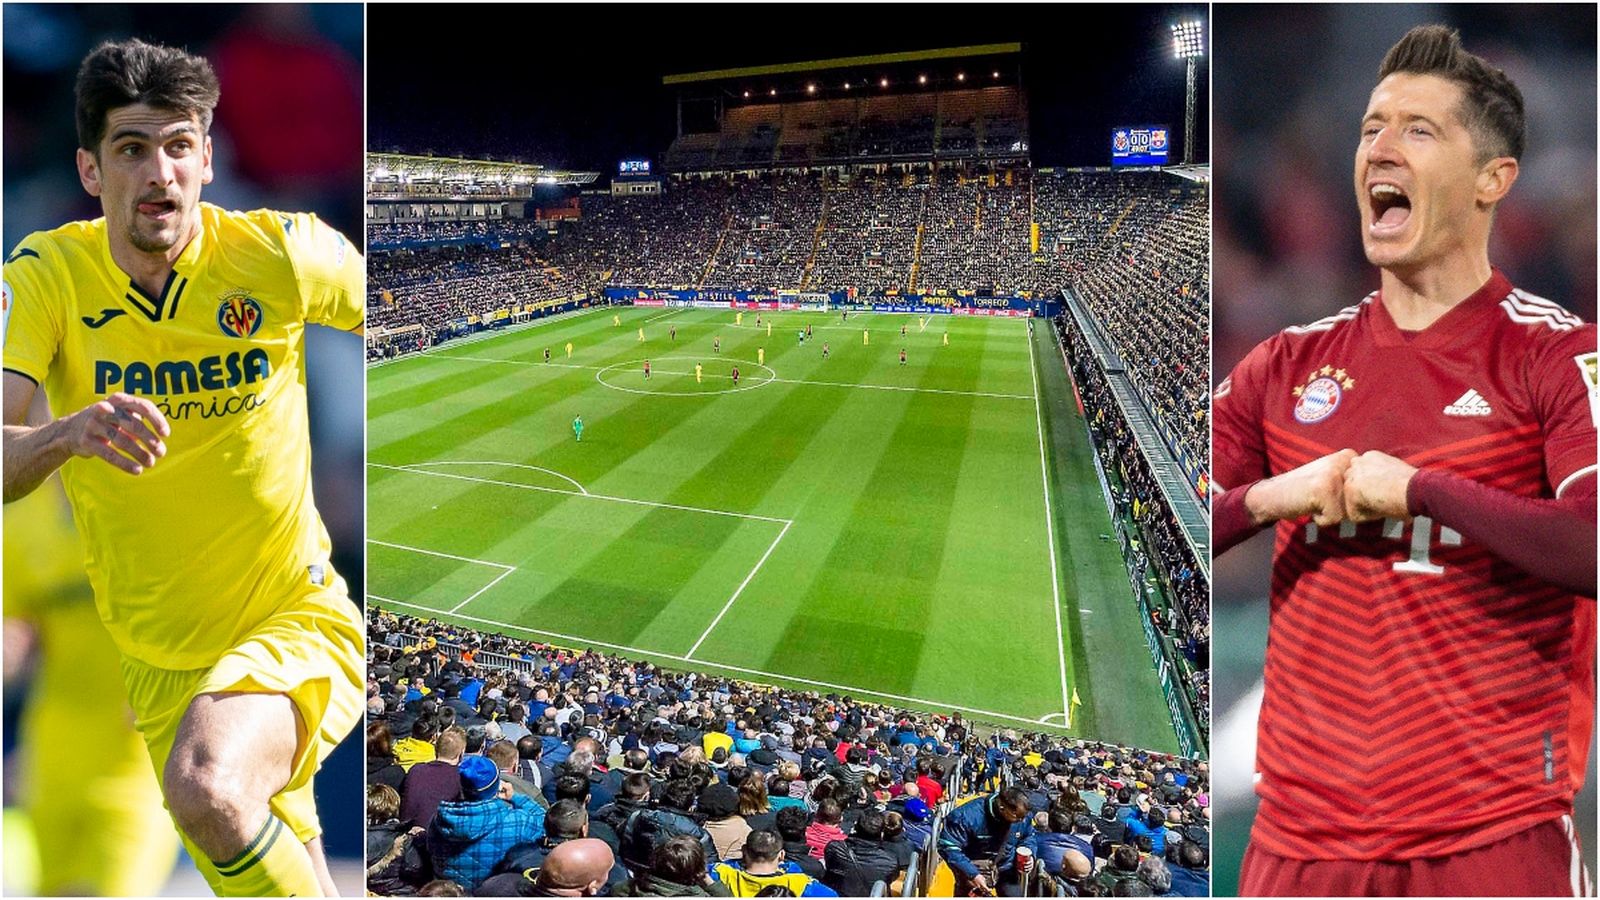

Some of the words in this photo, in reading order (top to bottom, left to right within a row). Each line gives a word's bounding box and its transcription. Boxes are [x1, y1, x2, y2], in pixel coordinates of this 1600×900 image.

[1131, 135, 1137, 145] 0
[1141, 134, 1148, 145] 0
[94, 348, 270, 395] PAMESA
[156, 393, 266, 420] ámica
